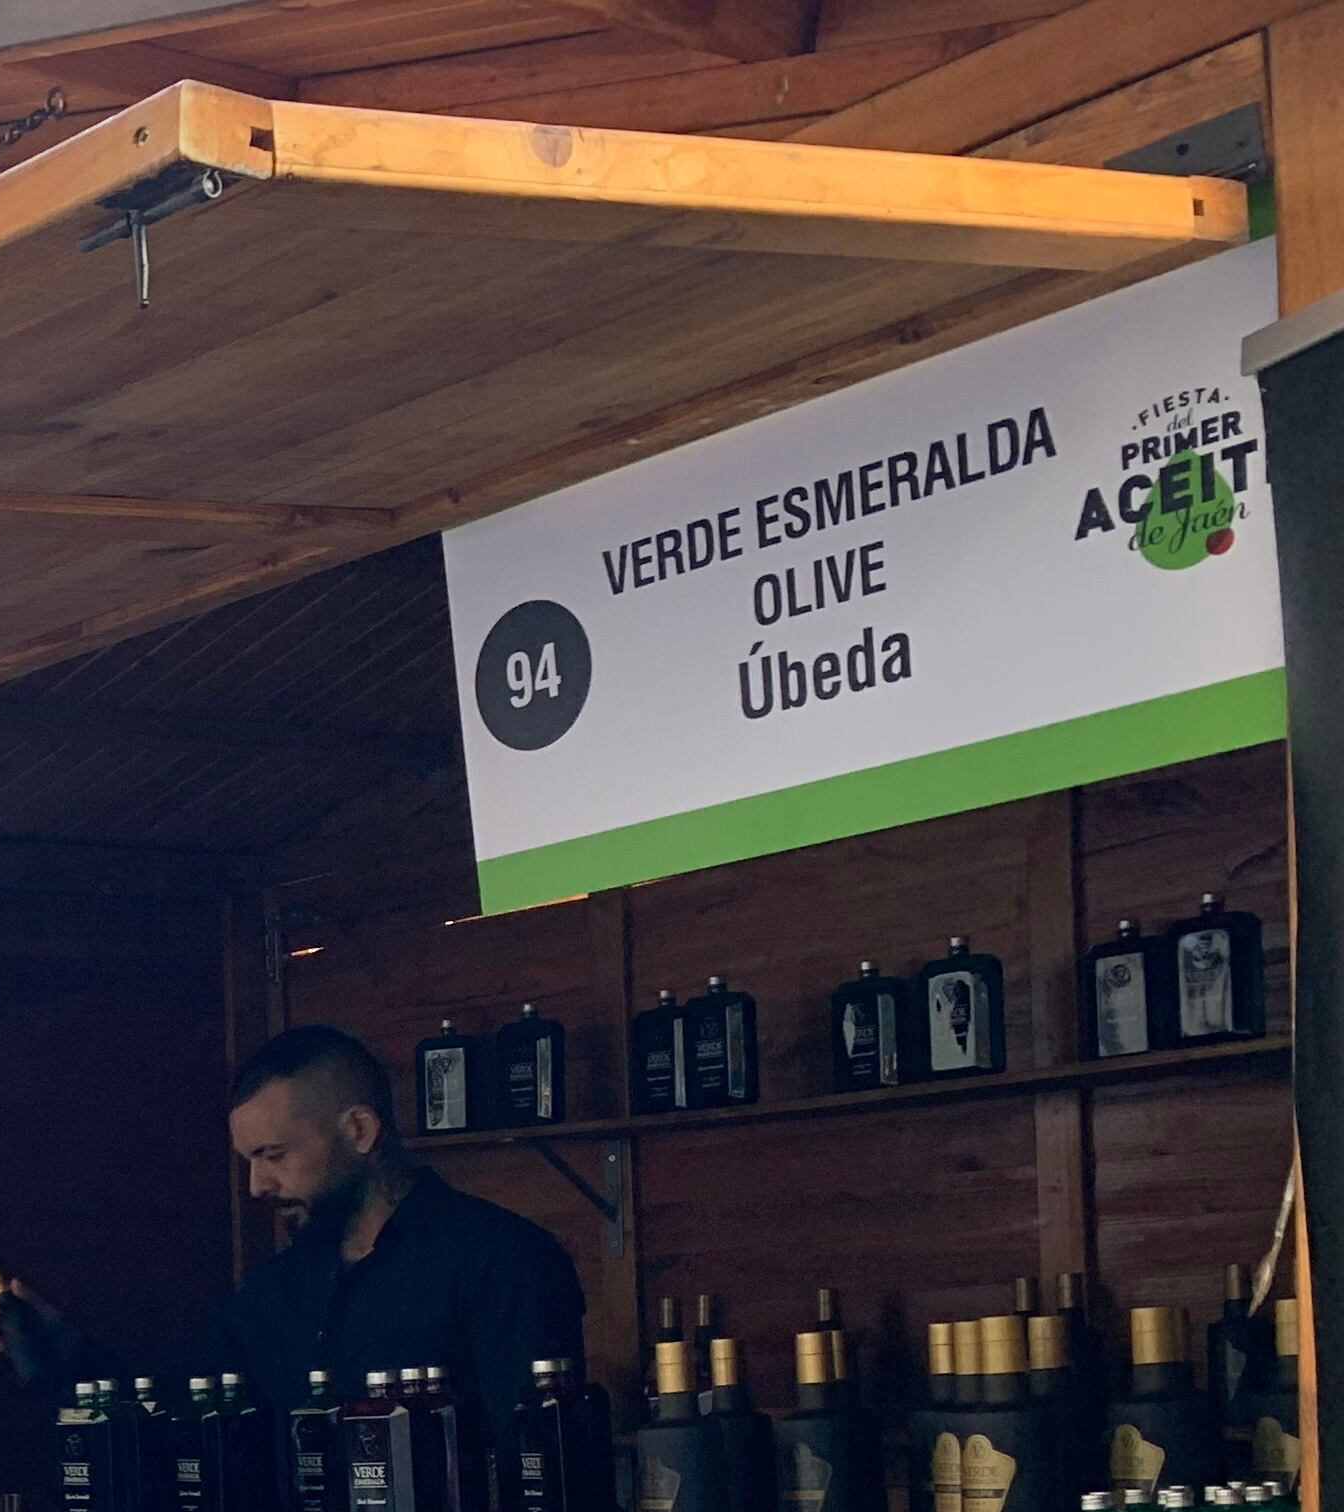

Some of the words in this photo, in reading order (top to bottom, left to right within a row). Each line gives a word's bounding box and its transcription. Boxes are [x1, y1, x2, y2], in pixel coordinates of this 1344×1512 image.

[1121, 410, 1243, 471] PRIMER
[1166, 408, 1194, 433] del
[602, 508, 744, 597] VERDE
[755, 406, 1058, 551] ESMERALDA
[1074, 438, 1271, 541] ACEIT
[1128, 515, 1165, 552] de
[1168, 499, 1251, 554] Jaén
[752, 542, 888, 627] OLIVE
[506, 642, 563, 709] 94
[737, 627, 914, 721] Úbeda
[354, 1465, 387, 1478] VERDE
